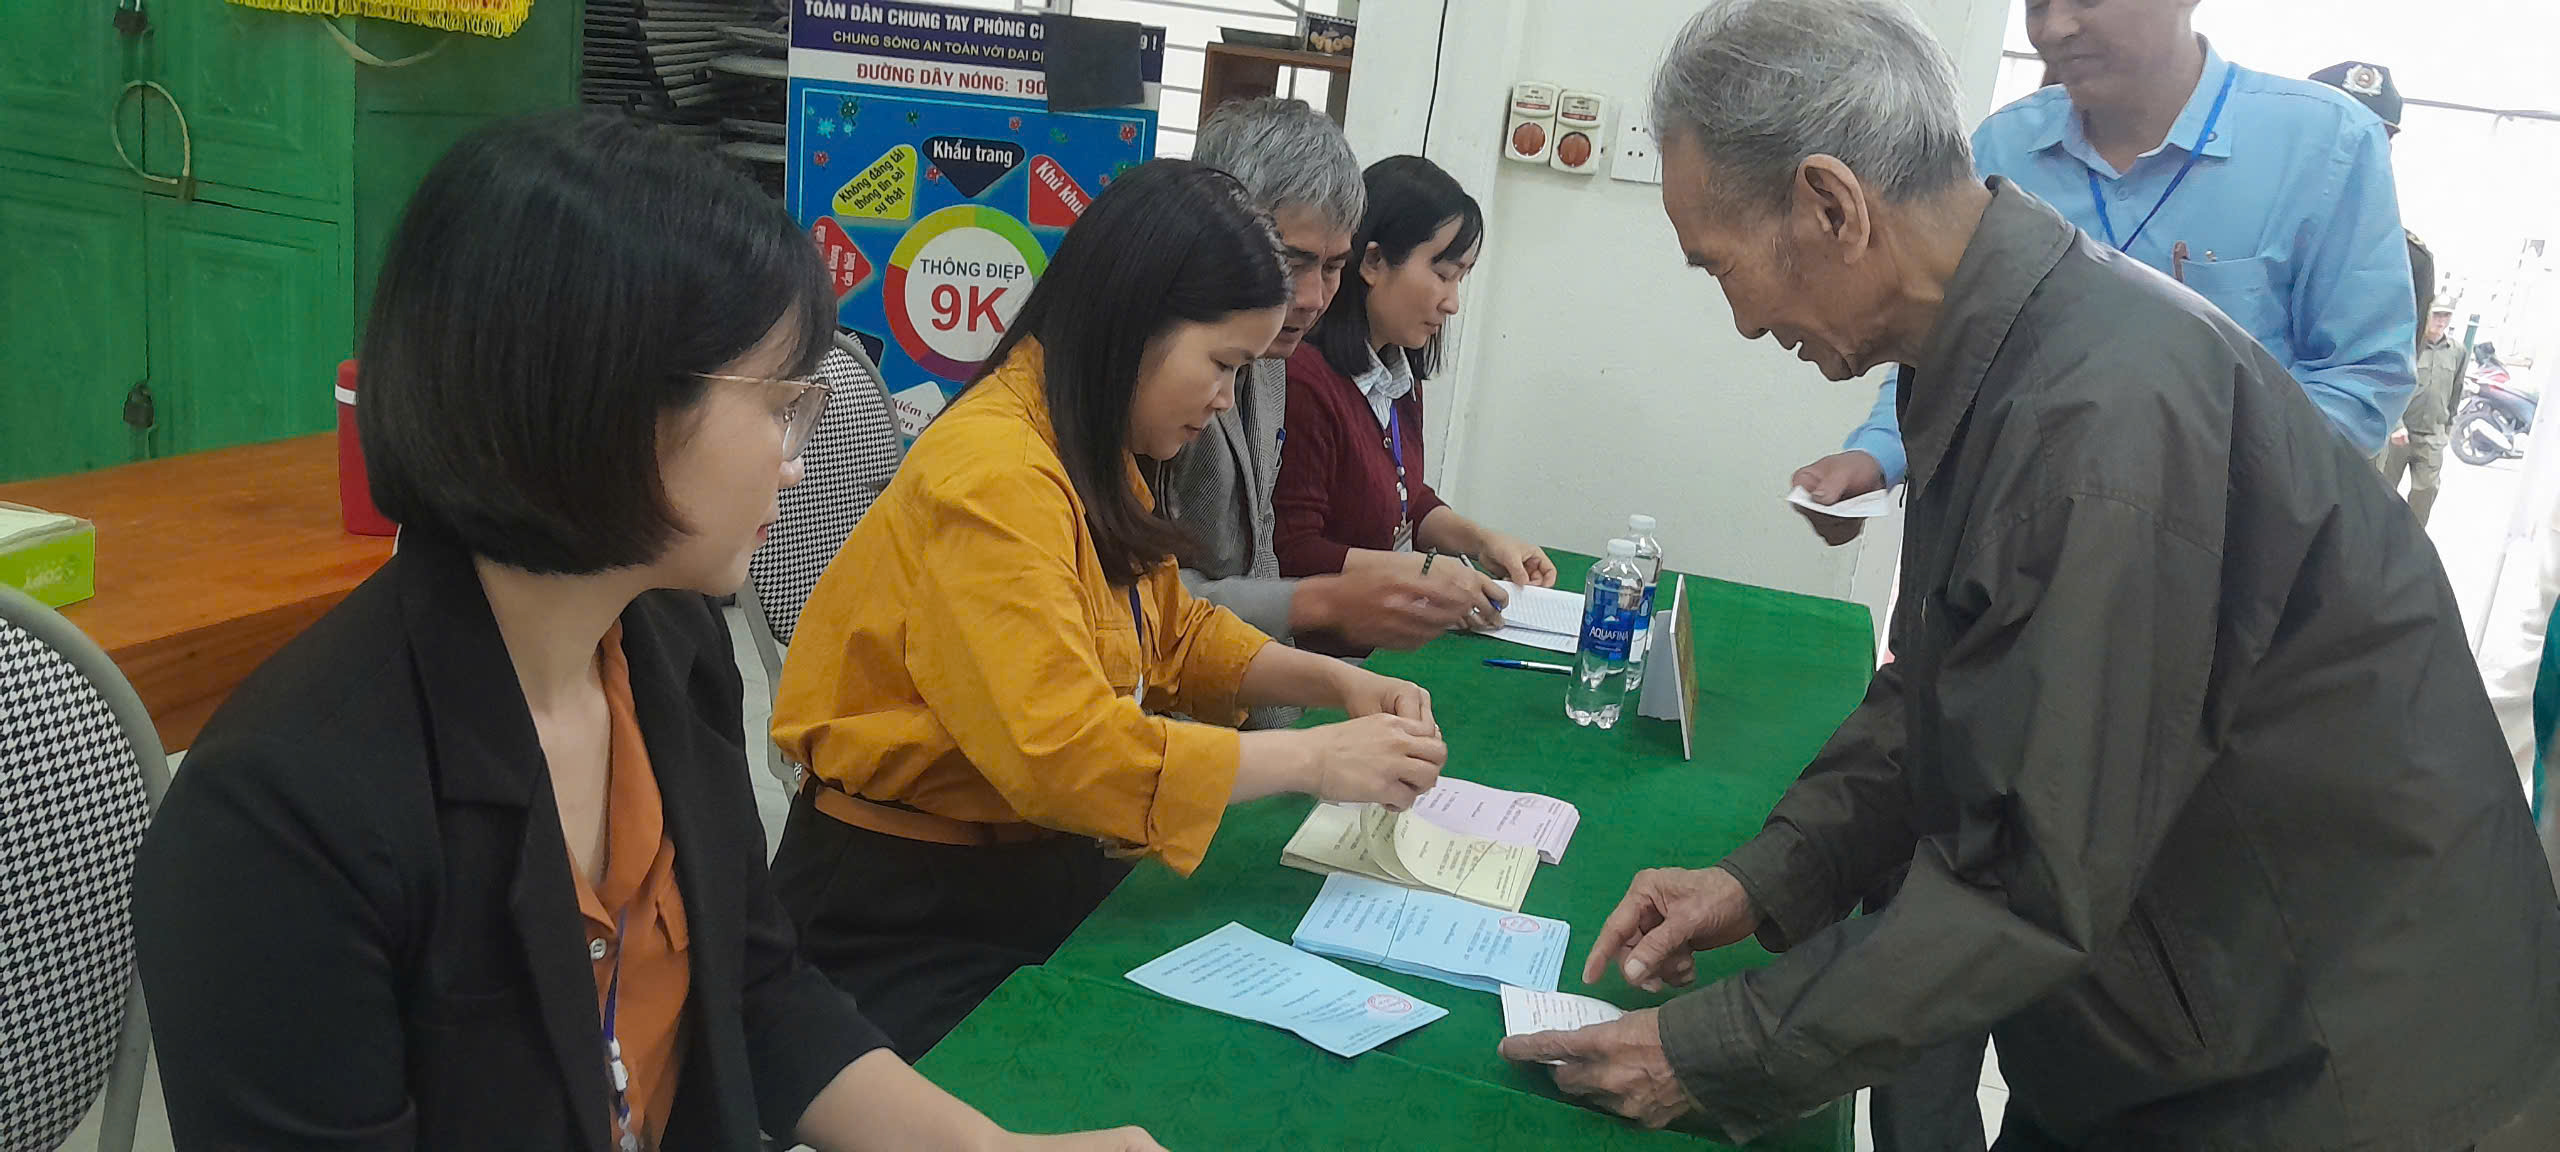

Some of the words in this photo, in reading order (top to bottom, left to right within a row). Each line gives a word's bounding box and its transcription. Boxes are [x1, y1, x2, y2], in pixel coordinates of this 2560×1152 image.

[850, 3, 884, 24] DÂN
[887, 9, 941, 30] CHUNG
[945, 14, 970, 33] TAY
[833, 30, 880, 47] CHUNG
[923, 40, 941, 53] AN
[857, 62, 915, 84] ĐƯỜNG
[920, 67, 954, 87] DÂY
[958, 71, 1009, 92] NÓNG:
[933, 139, 971, 161] Khẩu
[976, 144, 1013, 168] trang
[920, 256, 981, 277] THÔNG
[986, 262, 1025, 283] ĐIỆP
[931, 284, 1008, 334] 9K
[1589, 625, 1629, 642] AQUAFINA
